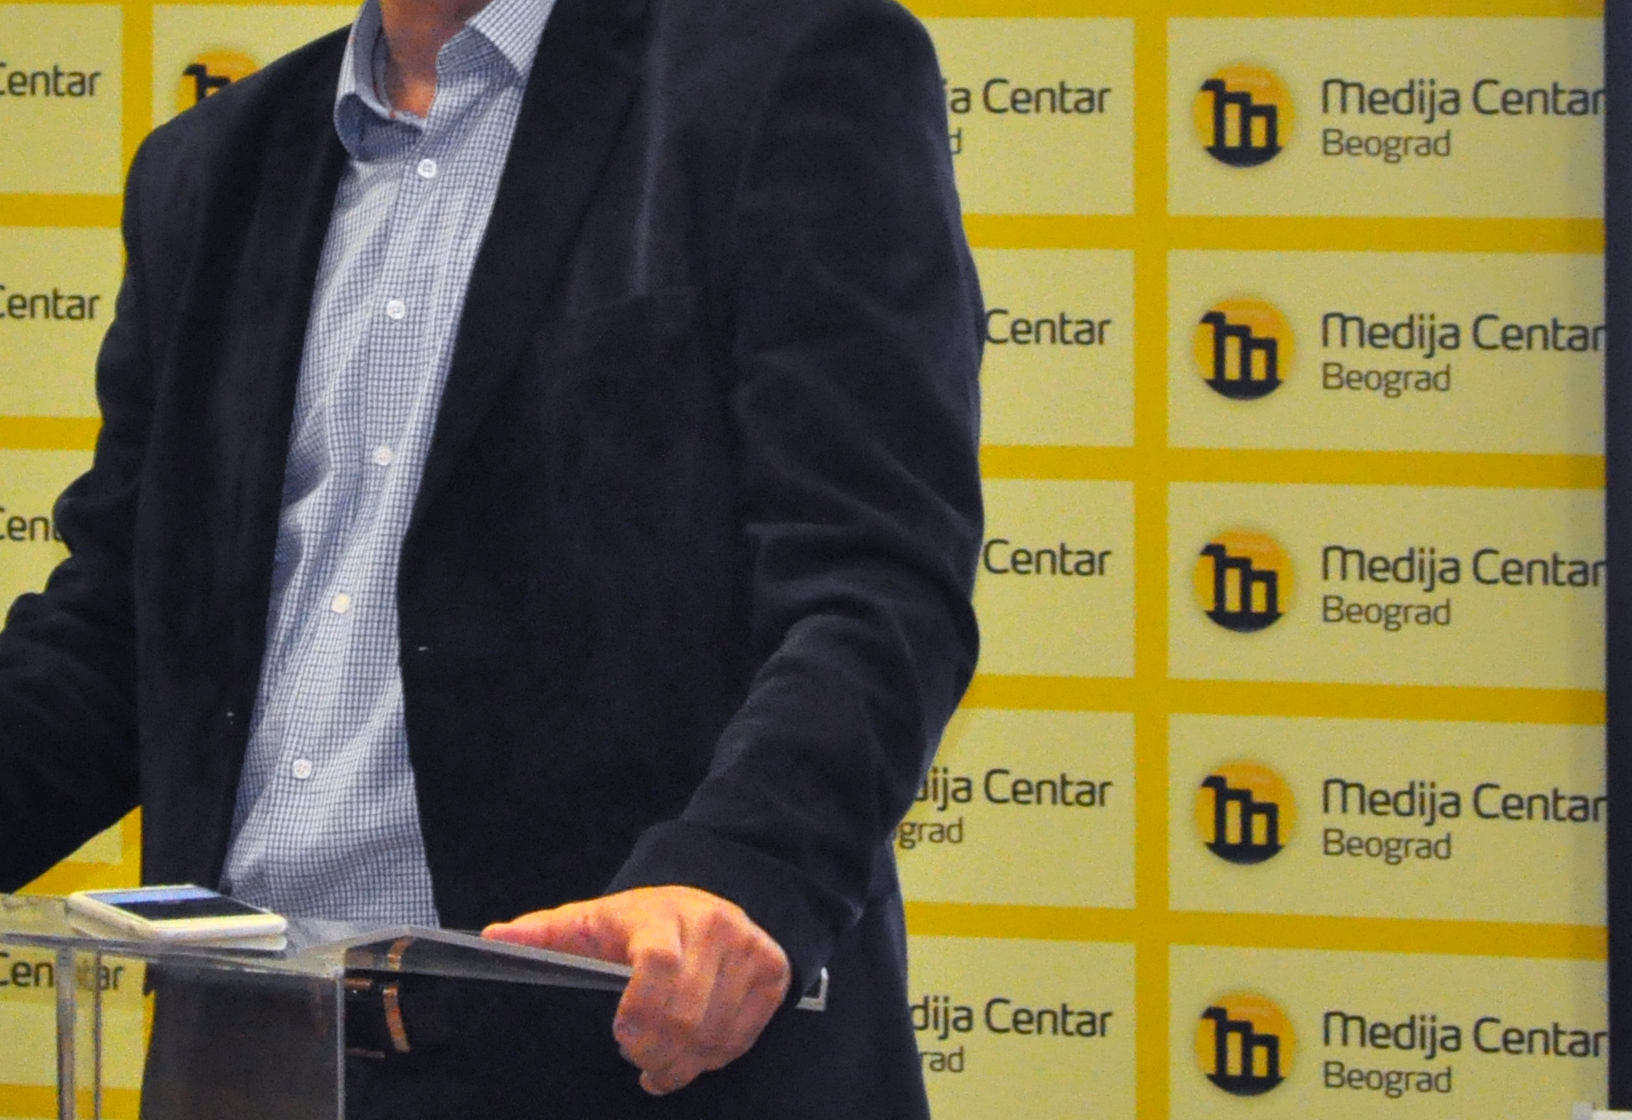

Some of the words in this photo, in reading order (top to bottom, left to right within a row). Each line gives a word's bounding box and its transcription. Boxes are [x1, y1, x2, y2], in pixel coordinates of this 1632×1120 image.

[982, 77, 1113, 115] Centar
[1322, 78, 1462, 125] Medija
[1322, 128, 1452, 164] Beograd
[1322, 311, 1462, 360] Medija
[1322, 362, 1452, 398] Beograd
[982, 538, 1113, 577] Centar
[1322, 544, 1462, 594] Medija
[1322, 595, 1452, 632] Beograd
[982, 767, 1113, 808] Centar
[1322, 777, 1462, 828] Medija
[1322, 828, 1452, 866] Beograd
[982, 997, 1113, 1038] Centar
[1322, 1010, 1462, 1061] Medija
[1322, 1060, 1452, 1099] Beograd
